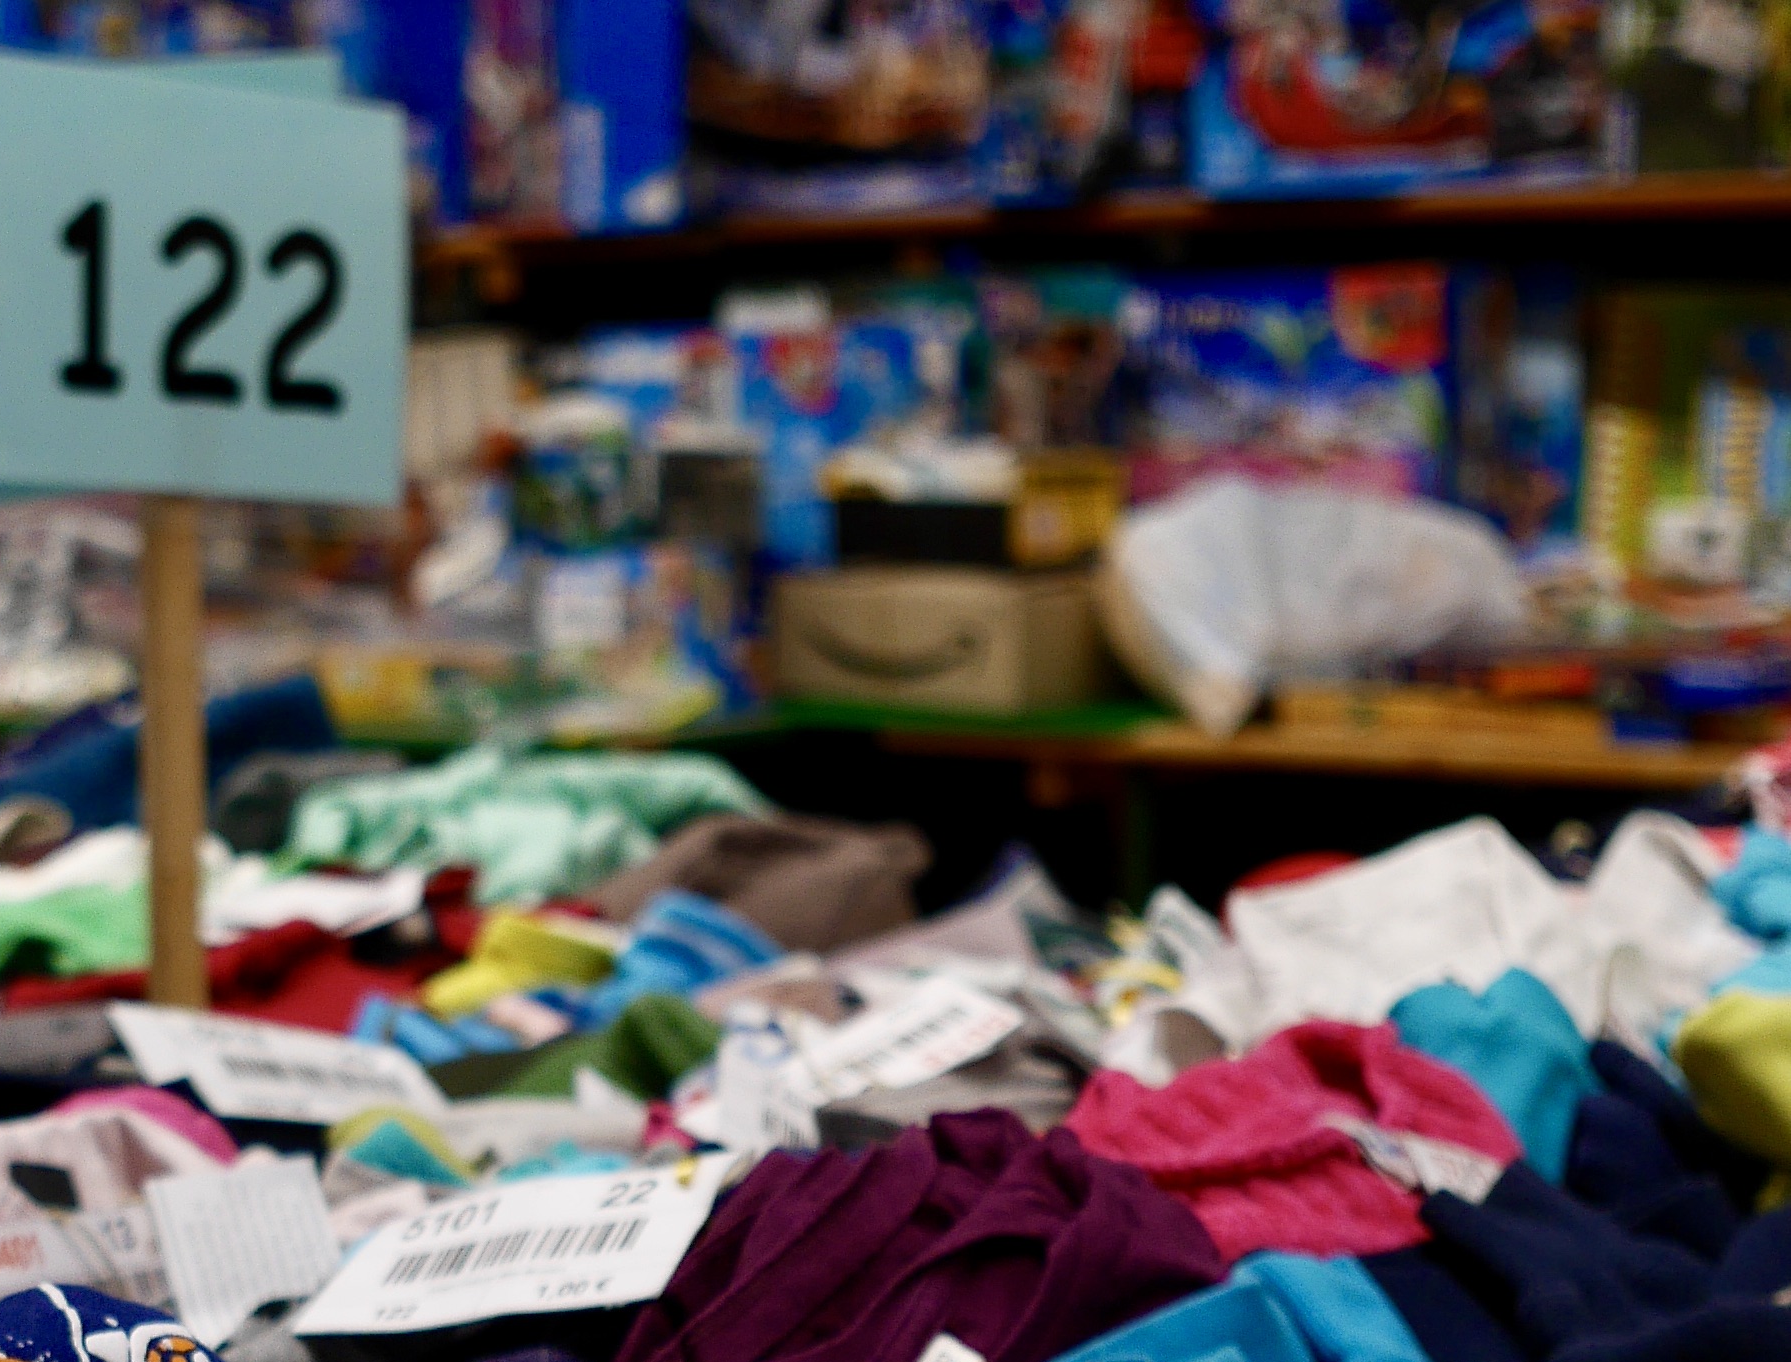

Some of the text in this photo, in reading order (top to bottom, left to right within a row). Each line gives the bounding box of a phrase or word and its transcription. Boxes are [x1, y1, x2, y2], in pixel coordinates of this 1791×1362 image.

[57, 194, 346, 414] 122
[402, 1179, 658, 1242] 5101 22
